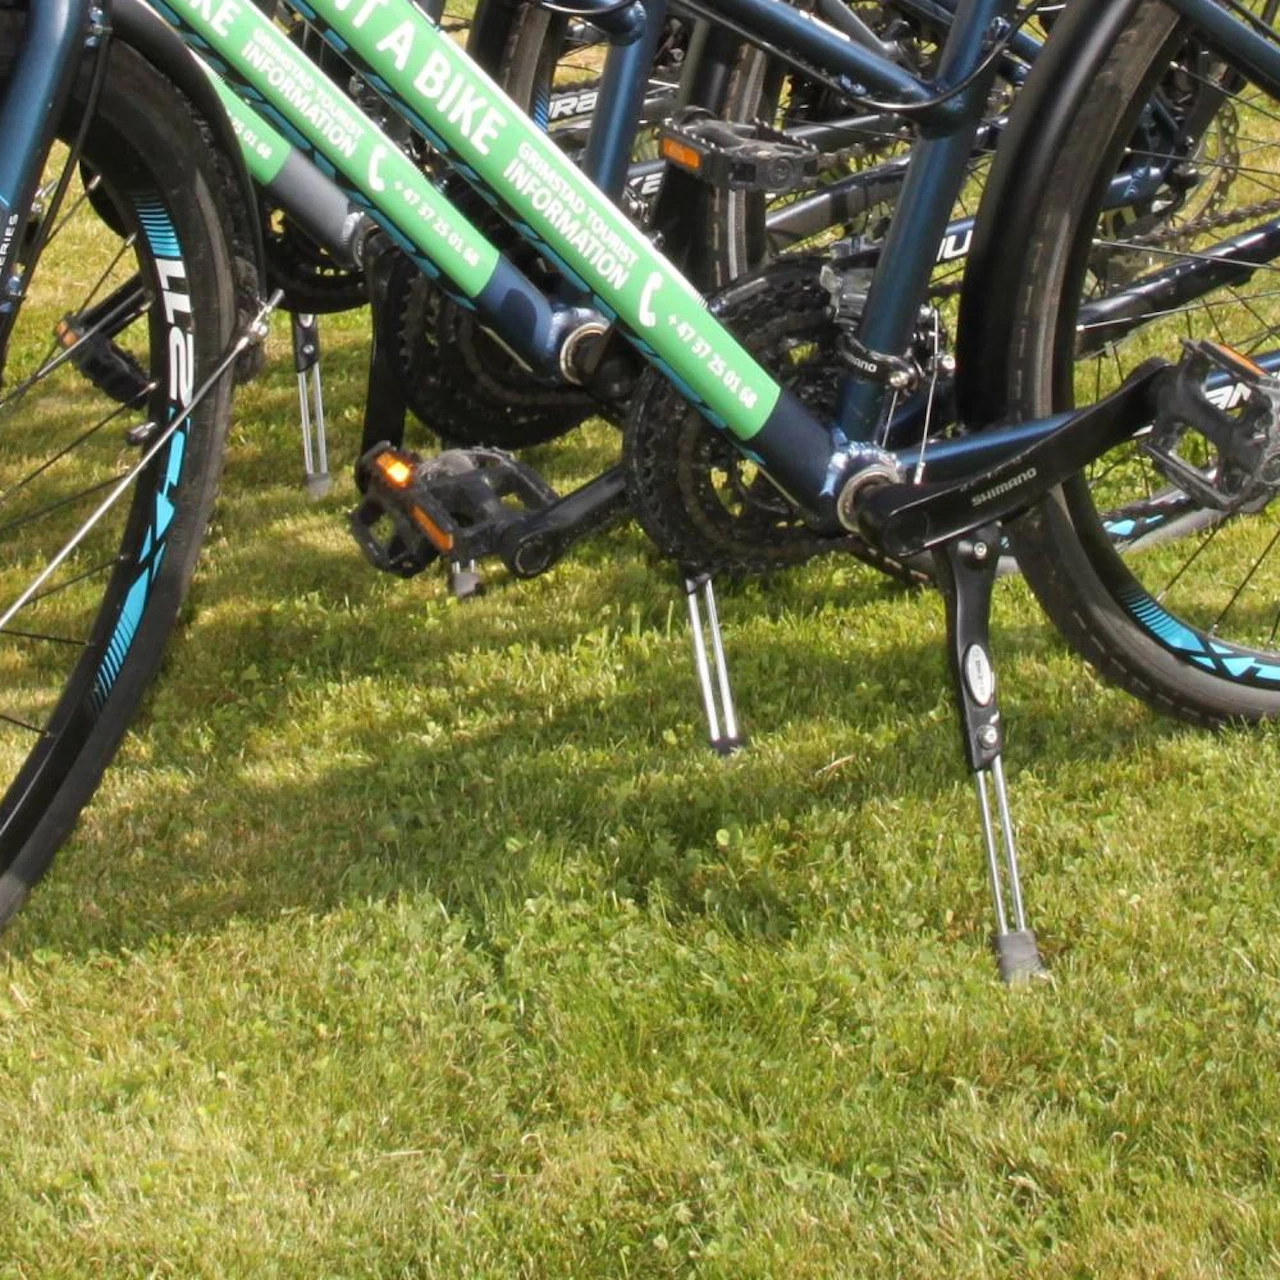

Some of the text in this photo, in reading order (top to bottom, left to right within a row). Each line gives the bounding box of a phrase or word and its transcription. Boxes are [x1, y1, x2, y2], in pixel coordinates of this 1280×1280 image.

[241, 43, 357, 158] INFORMATION
[315, 84, 365, 140] TOURIST
[376, 20, 416, 72] A
[414, 50, 507, 156] BIKE
[503, 158, 630, 291] INFORMATION
[518, 141, 640, 268] GRIMSTAD TOURIST
[677, 321, 696, 344] 47
[692, 335, 712, 358] 37
[708, 353, 727, 376] 25
[723, 367, 742, 391] 01
[739, 385, 758, 410] 68
[971, 466, 1038, 508] SHIMANO
